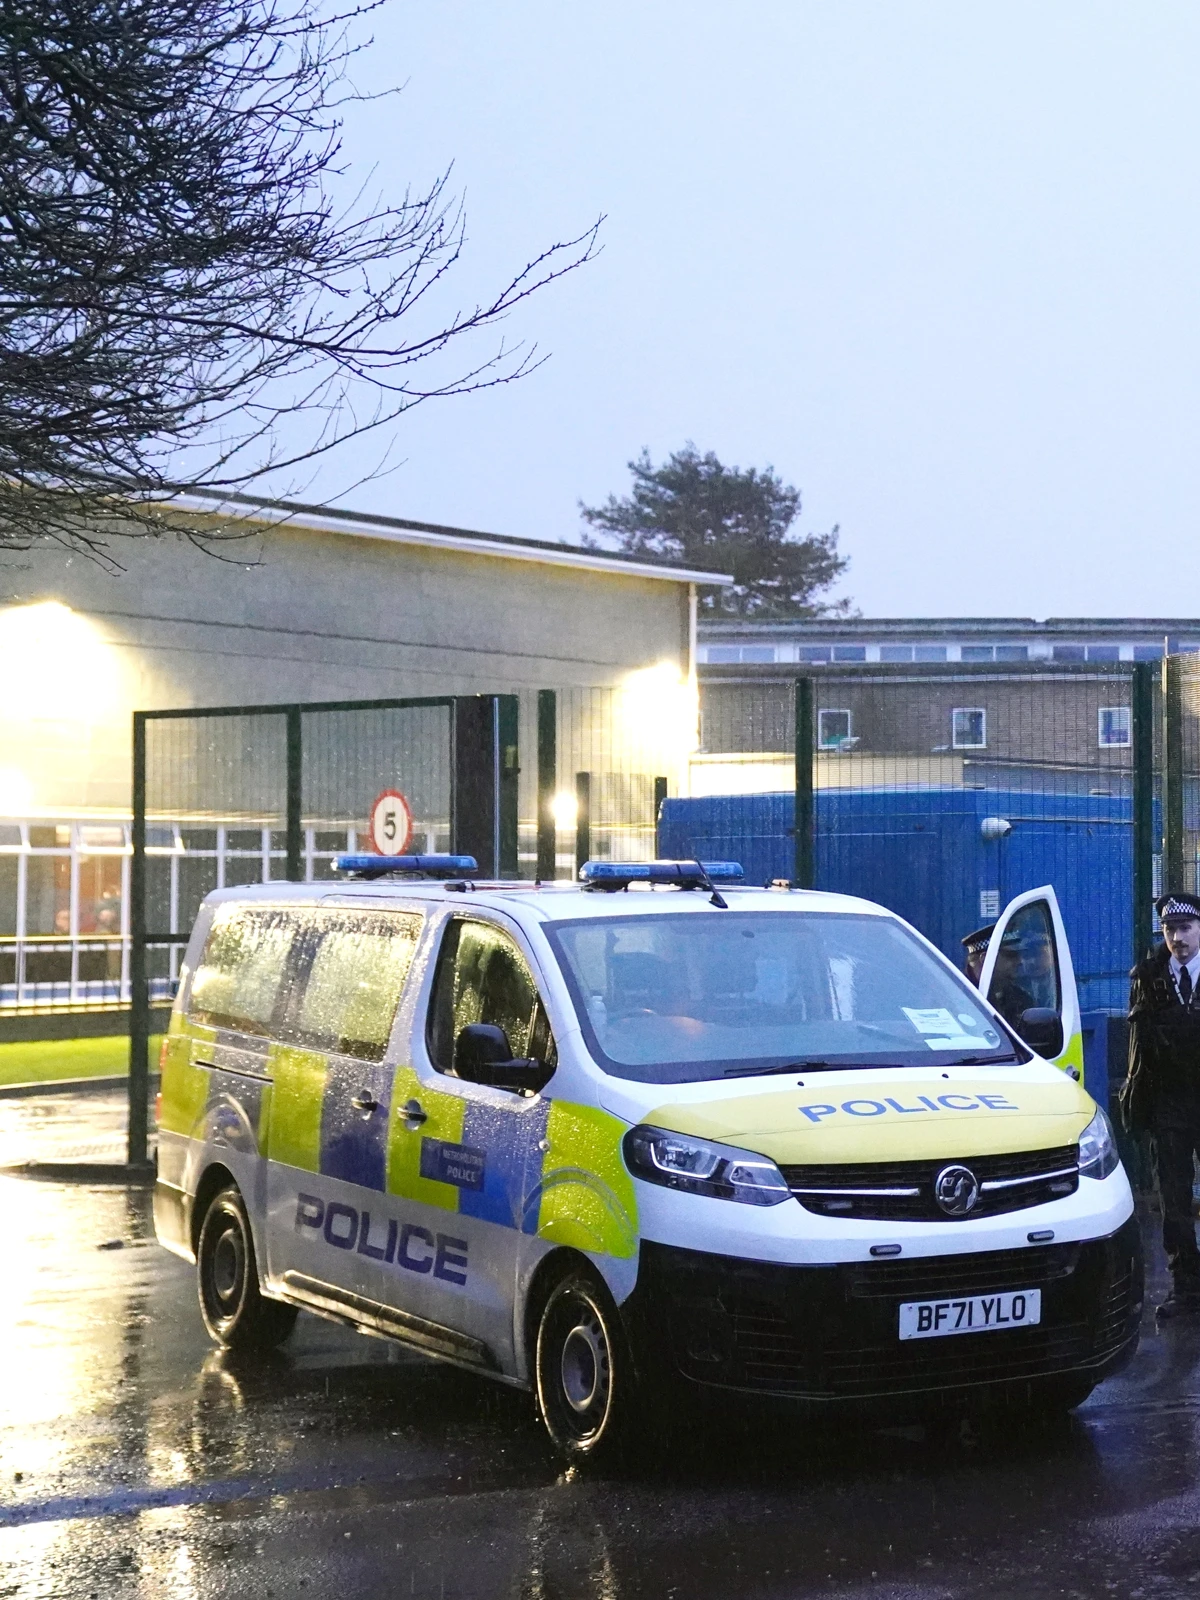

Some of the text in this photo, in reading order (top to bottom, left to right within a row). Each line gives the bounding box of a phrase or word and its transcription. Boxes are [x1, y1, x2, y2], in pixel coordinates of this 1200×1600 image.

[384, 811, 396, 840] 5
[797, 1094, 1019, 1123] POLICE
[446, 1165, 476, 1183] POLICE
[294, 1191, 469, 1286] POLICE
[916, 1295, 1026, 1332] BF71 YLO
